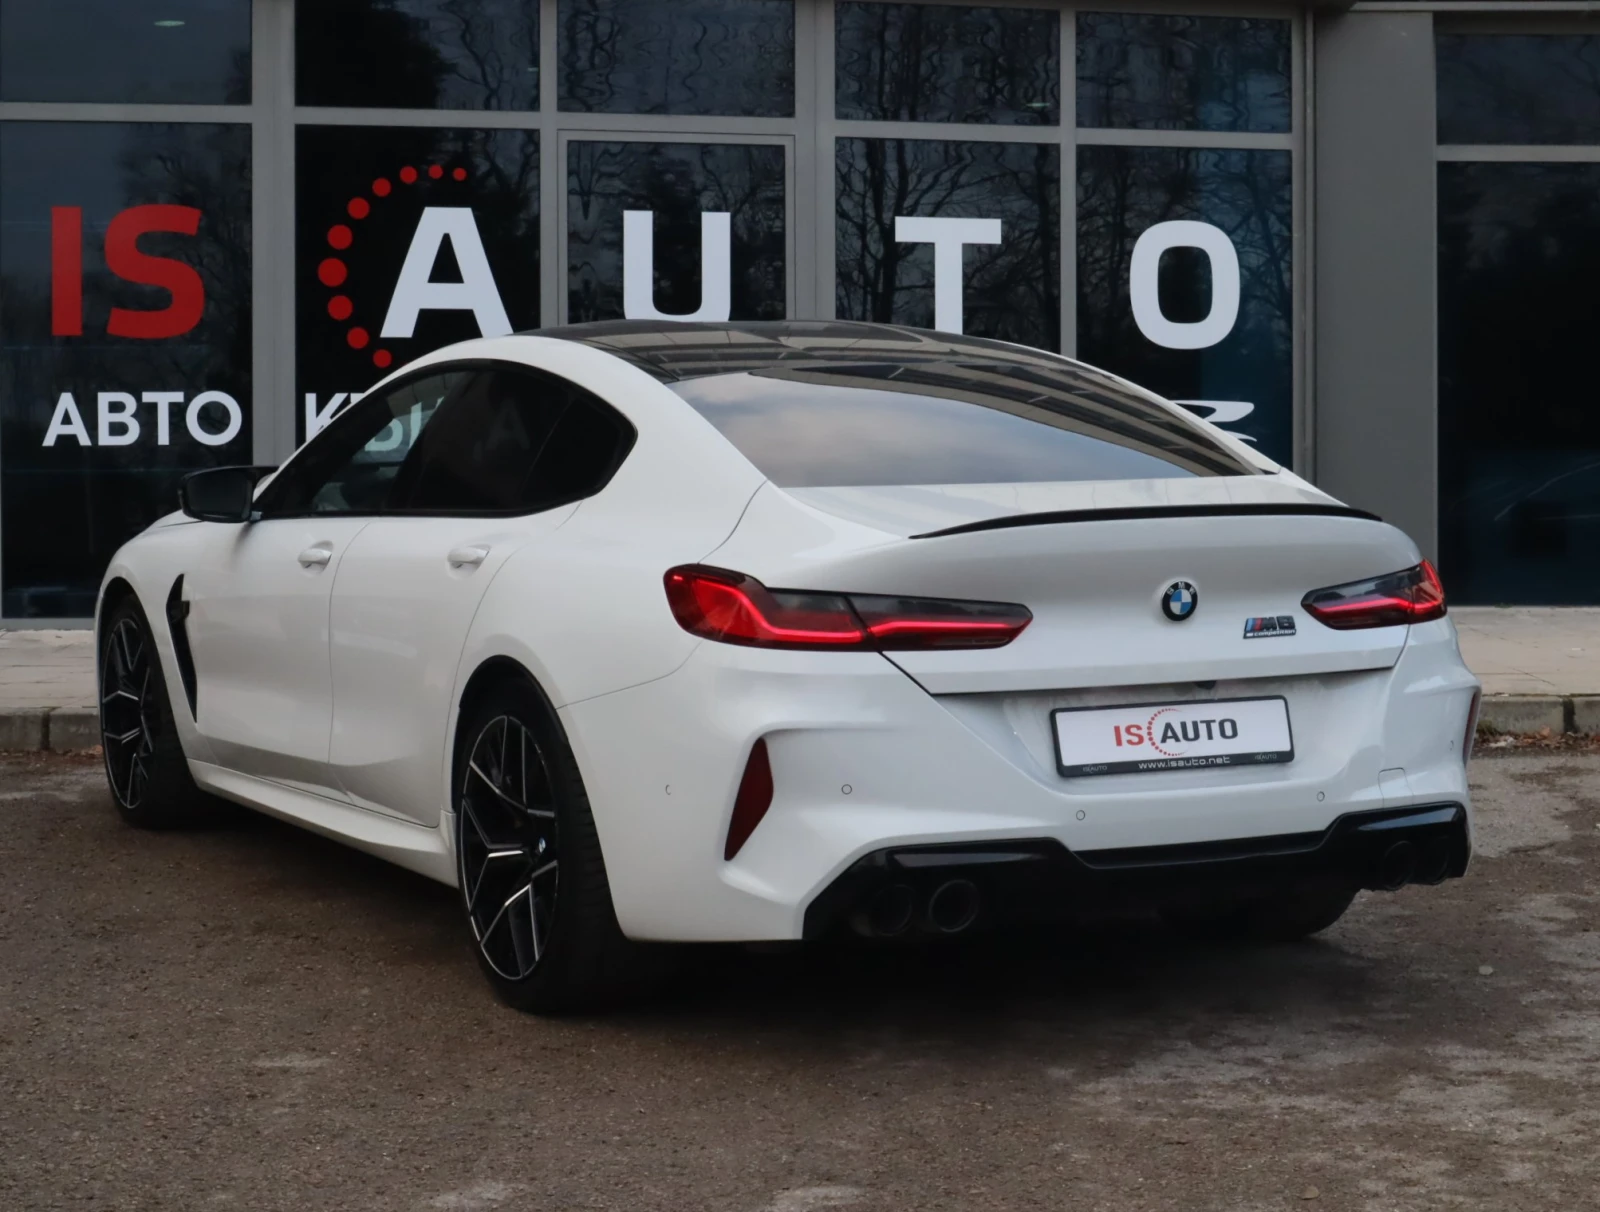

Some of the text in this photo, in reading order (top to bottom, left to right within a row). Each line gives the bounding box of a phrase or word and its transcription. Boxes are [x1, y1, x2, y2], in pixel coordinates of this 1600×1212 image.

[51, 204, 205, 339] IS
[42, 390, 242, 447] АВТО
[1113, 718, 1239, 747] IS AUTO
[1138, 755, 1231, 770] www.isauto.net
